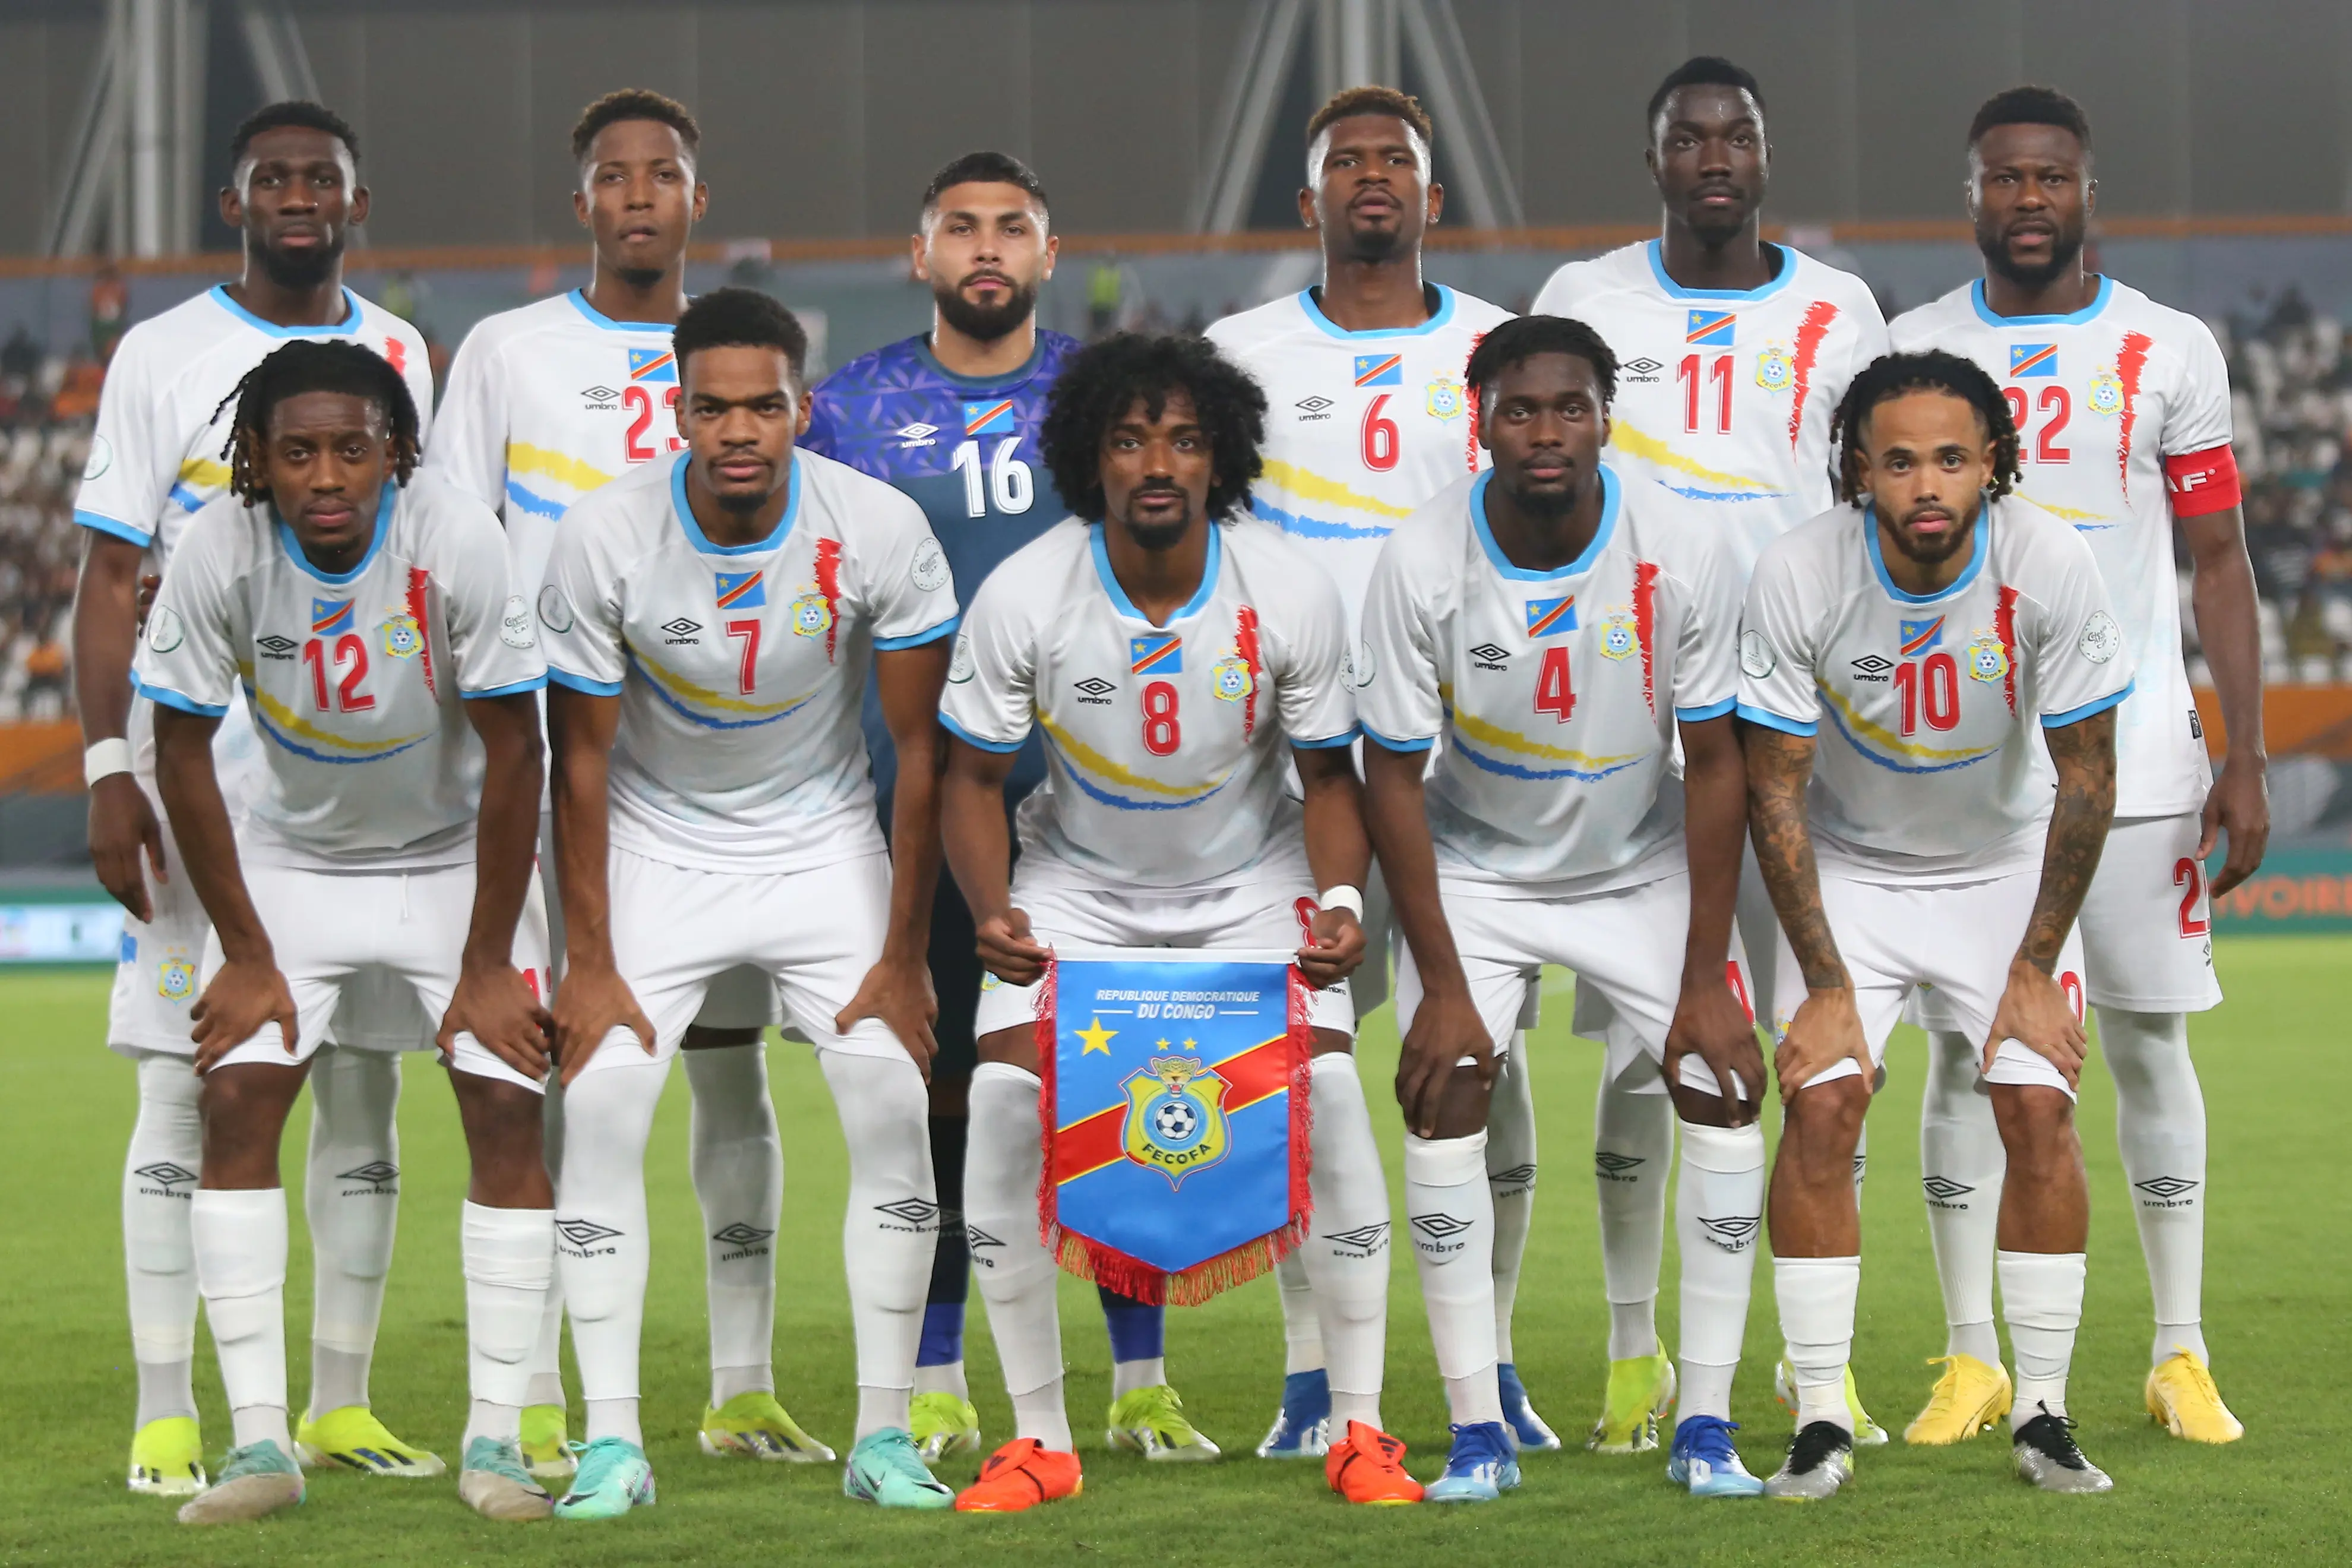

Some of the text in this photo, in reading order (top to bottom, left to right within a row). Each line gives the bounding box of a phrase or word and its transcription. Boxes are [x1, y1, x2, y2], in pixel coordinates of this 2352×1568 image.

[1627, 375, 1660, 383] umbro
[1677, 354, 1734, 435] 11
[1299, 412, 1331, 422] umbro
[1361, 393, 1401, 472] 6
[902, 438, 937, 448] umbro
[953, 437, 1035, 519] 16
[665, 637, 699, 645] umbro
[261, 652, 295, 660] umbro
[726, 619, 761, 696] 7
[1474, 660, 1507, 671] umbro
[303, 634, 375, 713] 12
[1854, 674, 1889, 682] umbro
[1534, 646, 1577, 725] 4
[1077, 696, 1112, 705] umbro
[1893, 653, 1961, 737] 10
[1141, 681, 1181, 757] 8
[2173, 856, 2211, 938] 2
[1096, 990, 1260, 1003] REPUBLIQUE DEMOCRATIQUE
[1325, 985, 1346, 996] mbro
[1137, 1003, 1216, 1020] DU CONGO
[1142, 1142, 1212, 1165] FECOFA
[140, 1187, 192, 1199] umbro
[1926, 1199, 1968, 1210] mbro
[2144, 1199, 2193, 1207] umbro
[879, 1222, 939, 1233] umbro
[559, 1244, 617, 1259] umbro
[722, 1247, 769, 1262] umbro
[1333, 1238, 1389, 1259] umbro
[973, 1253, 994, 1268] bro
